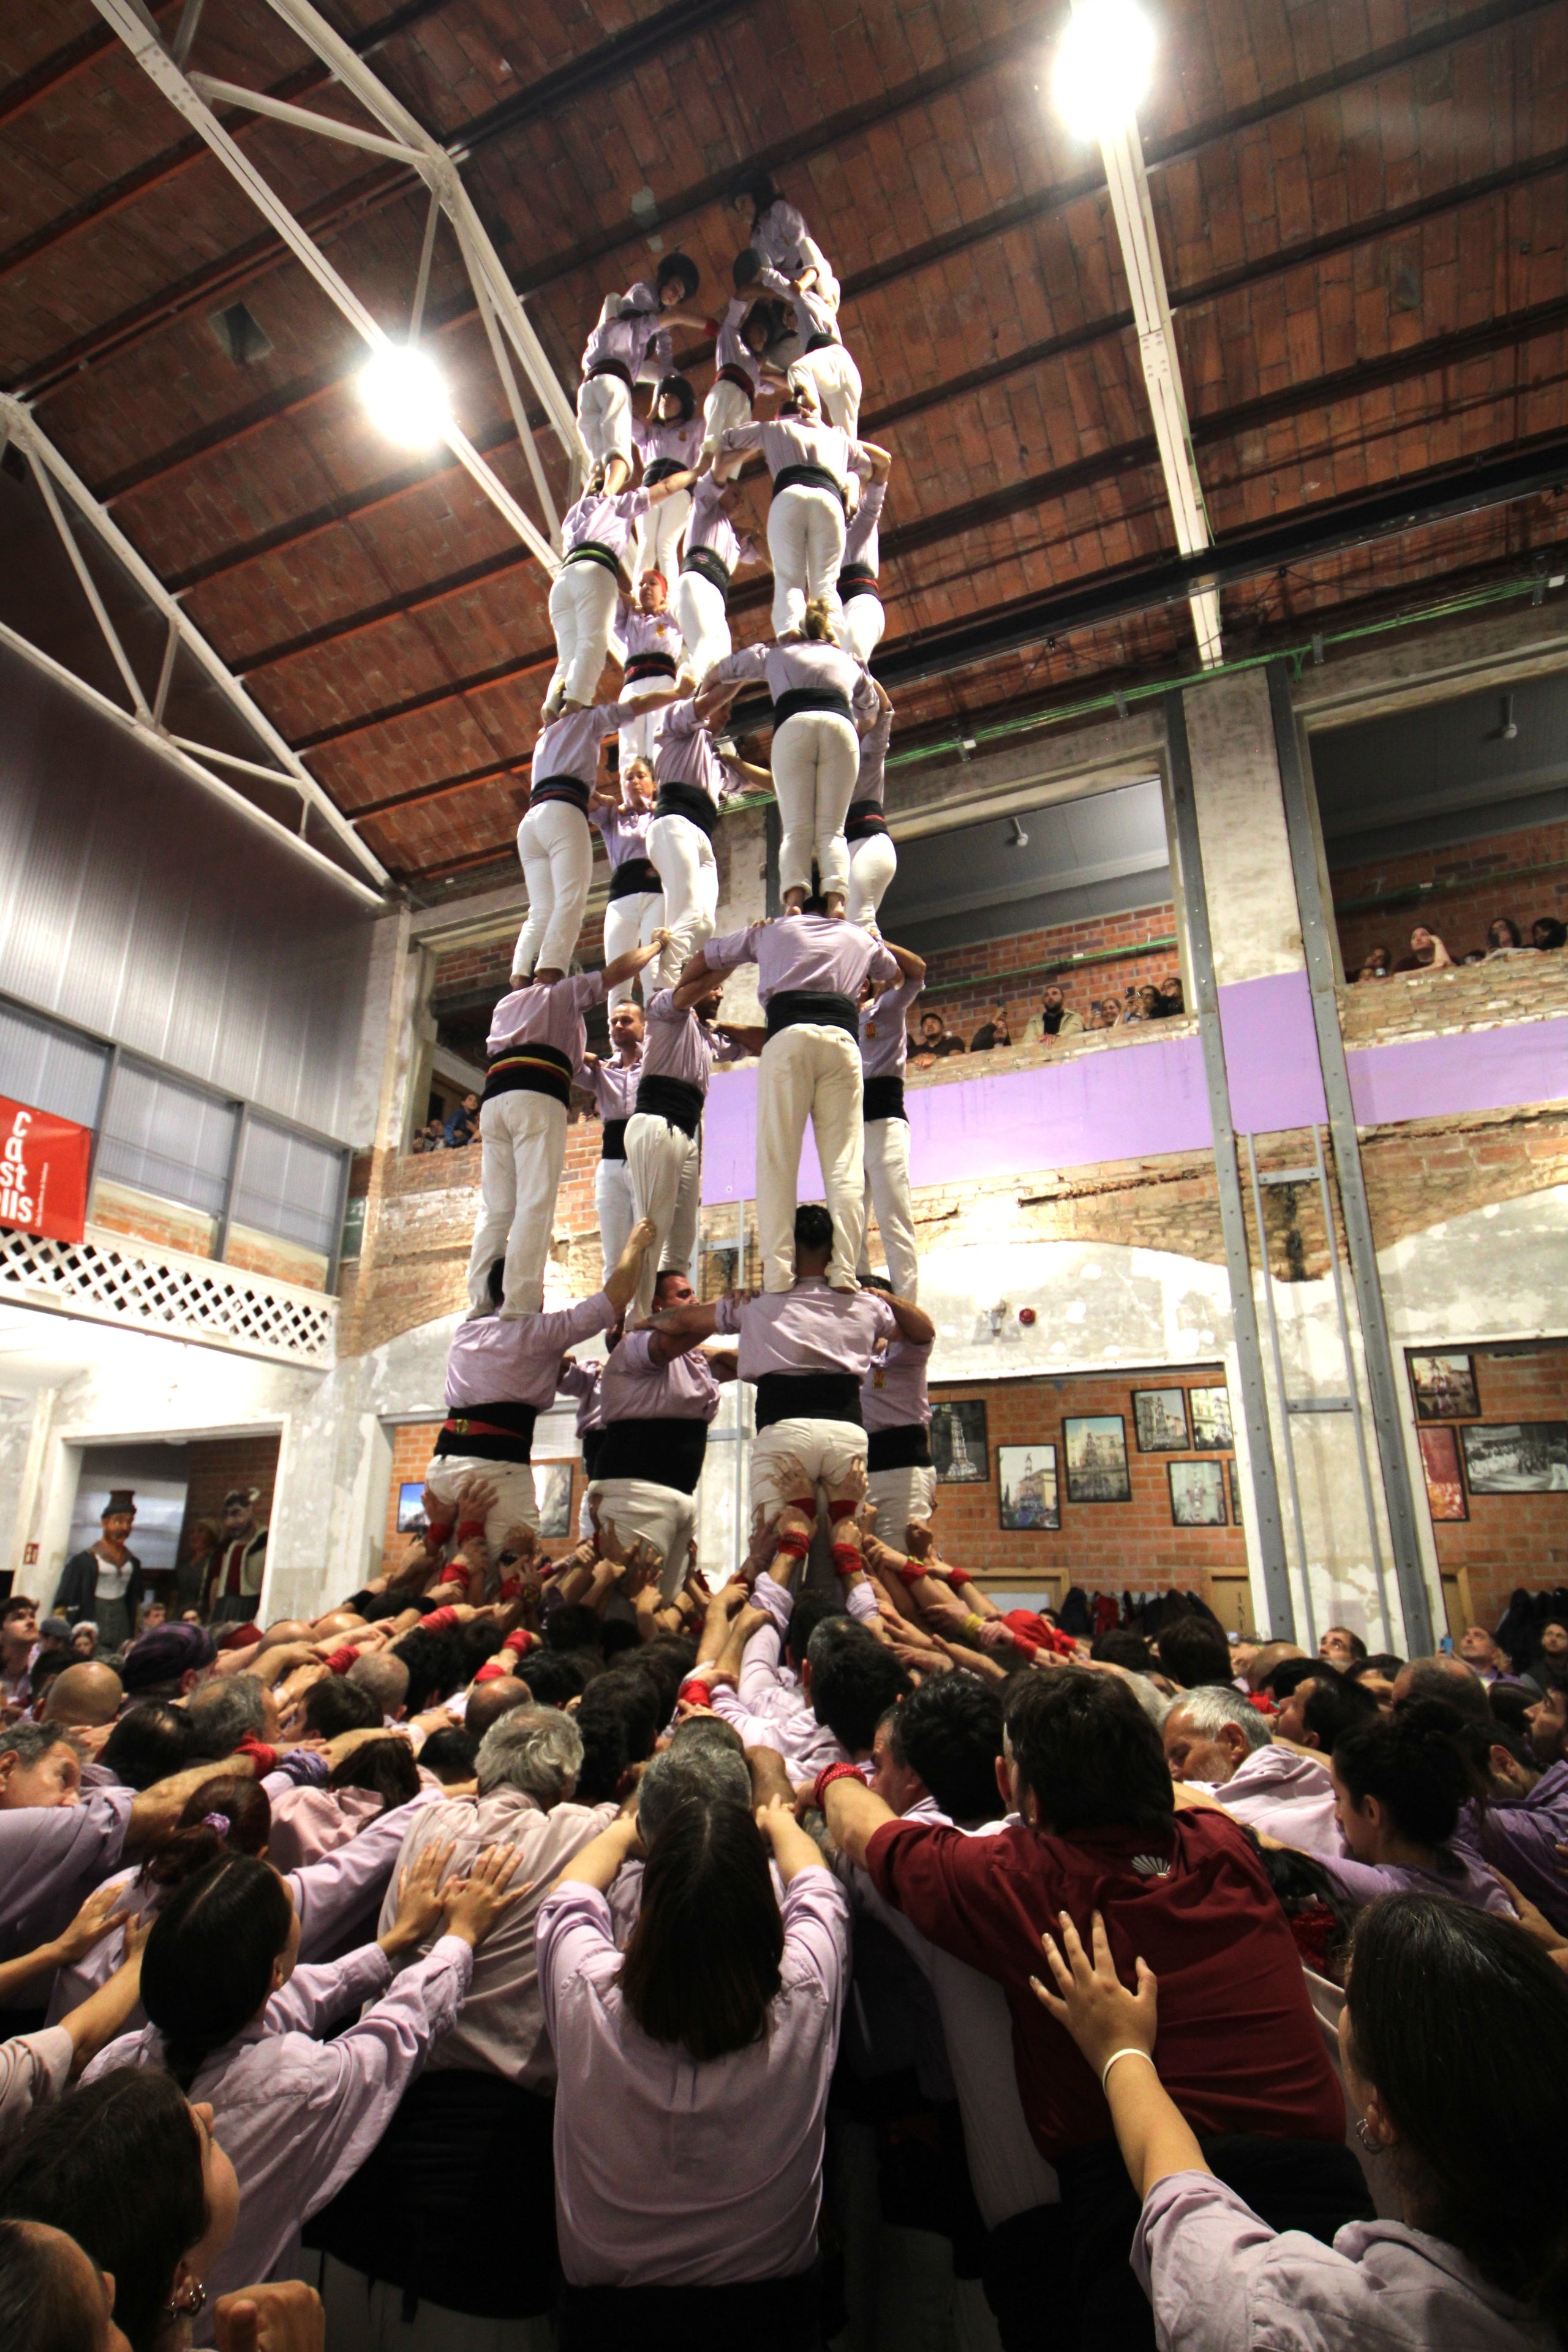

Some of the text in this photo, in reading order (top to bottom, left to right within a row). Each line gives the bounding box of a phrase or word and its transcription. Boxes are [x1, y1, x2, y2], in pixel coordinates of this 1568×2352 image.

[5, 1136, 23, 1163] a
[0, 1161, 28, 1193] st
[0, 1187, 33, 1223] lls
